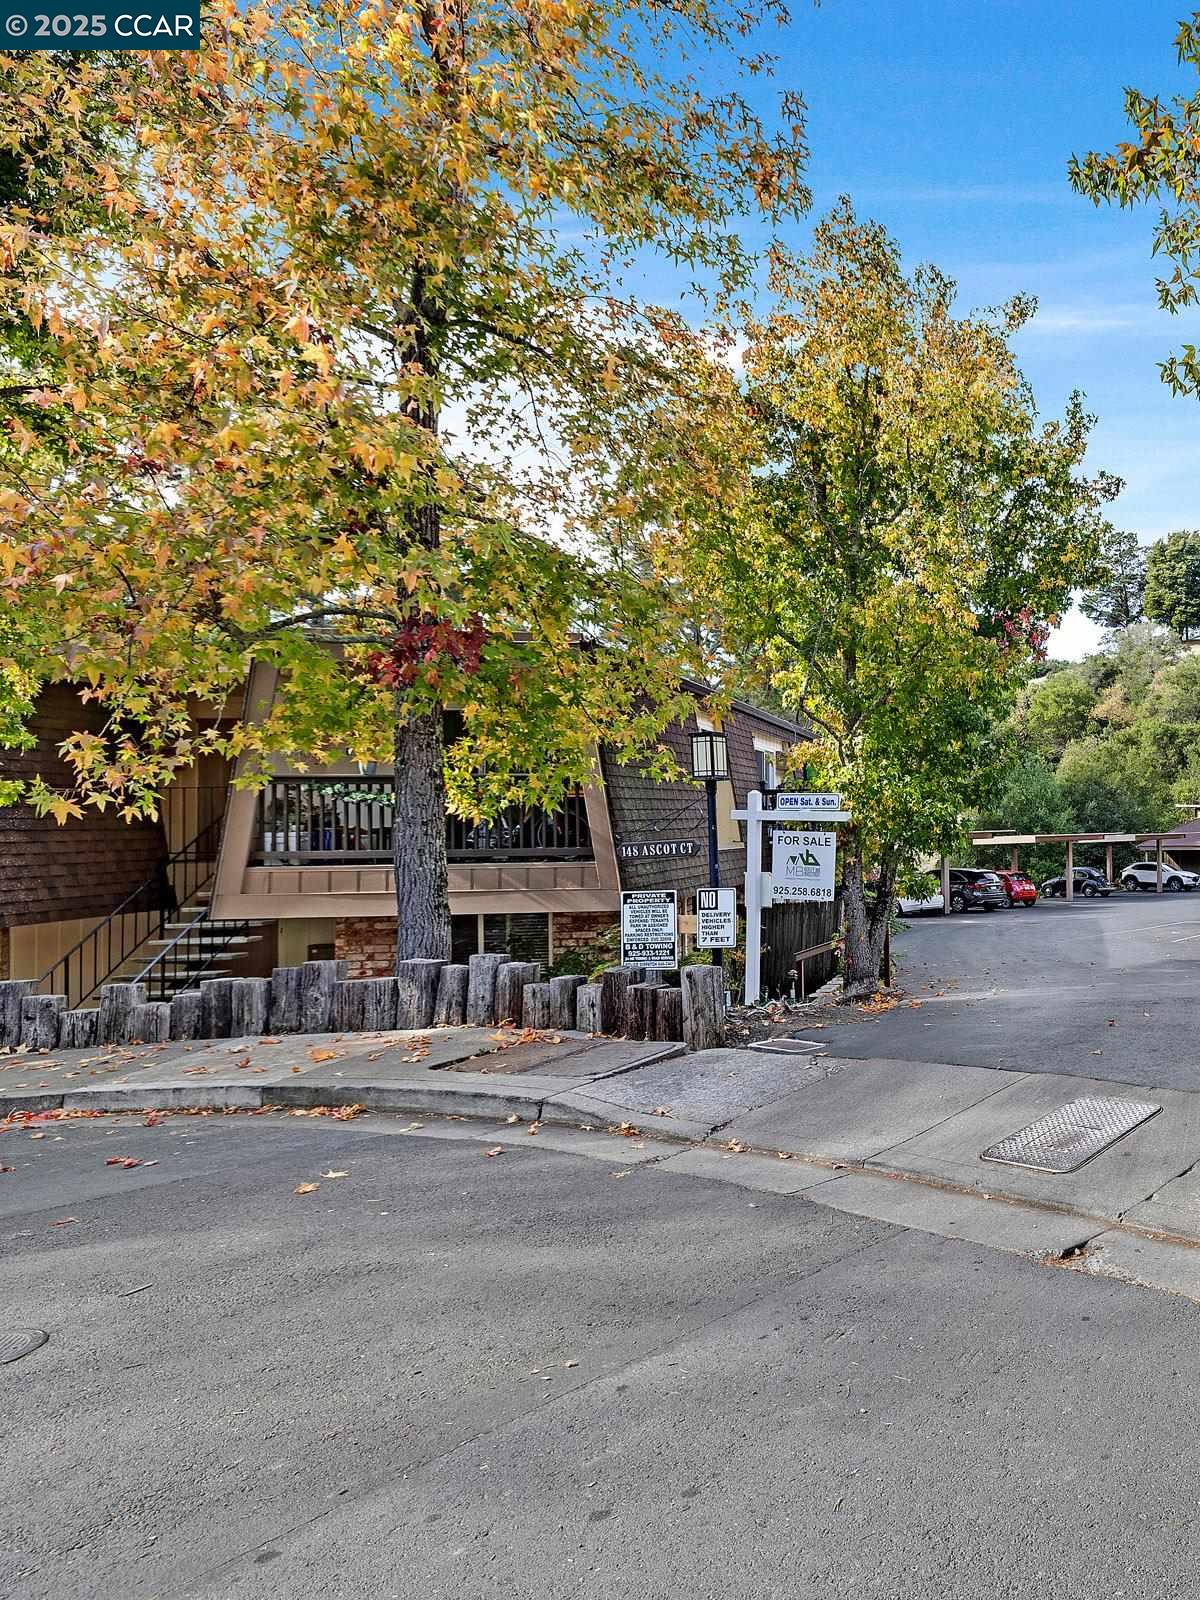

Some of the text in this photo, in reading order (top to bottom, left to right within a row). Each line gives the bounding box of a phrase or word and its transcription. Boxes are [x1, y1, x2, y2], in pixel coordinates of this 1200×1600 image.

[780, 797, 798, 806] OPEN
[800, 797, 813, 806] Sat.
[822, 797, 836, 806] Sun.
[777, 835, 832, 847] FOR SALE
[622, 842, 693, 857] 148 ASCOT CT
[773, 886, 832, 897] 925.258.6818
[700, 891, 716, 908] NO
